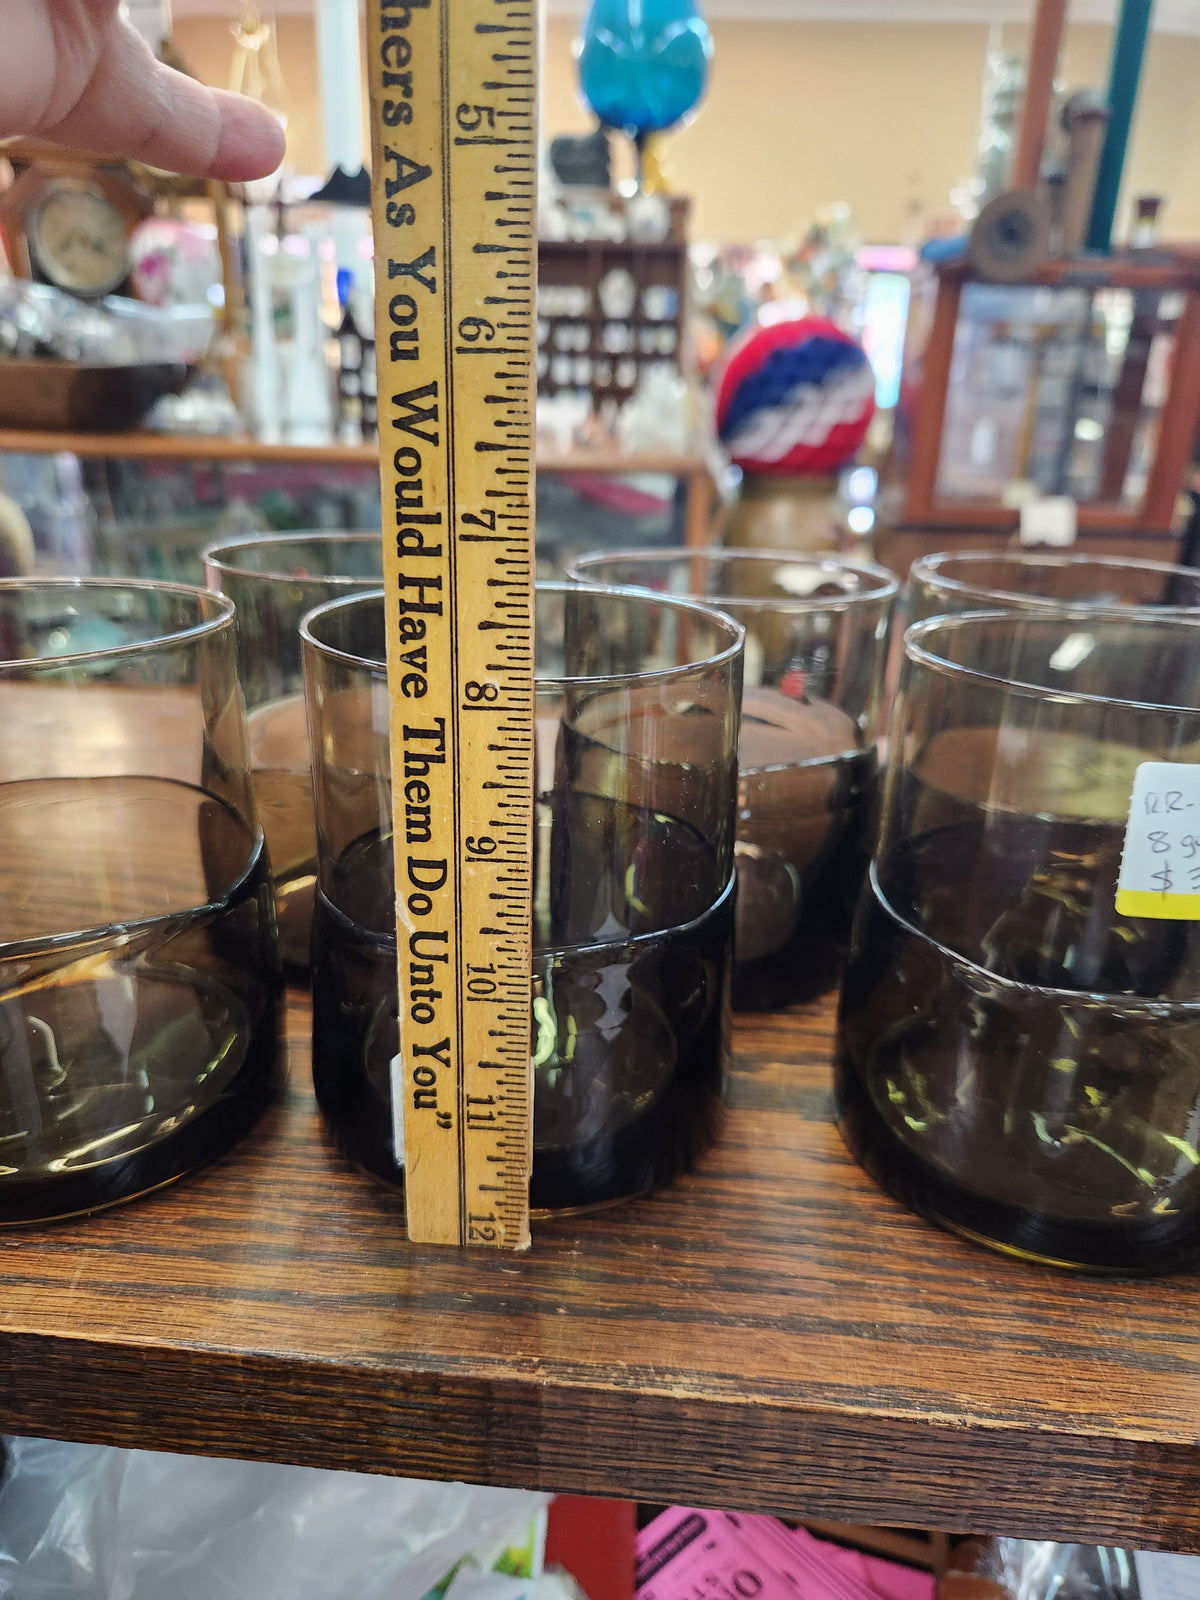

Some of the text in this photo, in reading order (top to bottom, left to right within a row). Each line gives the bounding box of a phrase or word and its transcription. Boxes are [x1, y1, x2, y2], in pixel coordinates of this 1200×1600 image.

[455, 103, 496, 132] 5
[383, 146, 433, 228] As
[387, 245, 437, 363] You
[457, 316, 495, 342] 6
[391, 380, 443, 558] Would
[461, 509, 496, 531] 7
[397, 573, 443, 699] Have
[465, 680, 499, 701] 8
[402, 717, 446, 844] Them
[465, 836, 497, 855] 9
[1147, 831, 1171, 853] 8
[406, 856, 448, 916] Do
[408, 930, 449, 1025] Unto
[466, 962, 498, 995] 10
[466, 1094, 497, 1126] 11
[467, 1212, 497, 1241] 12
